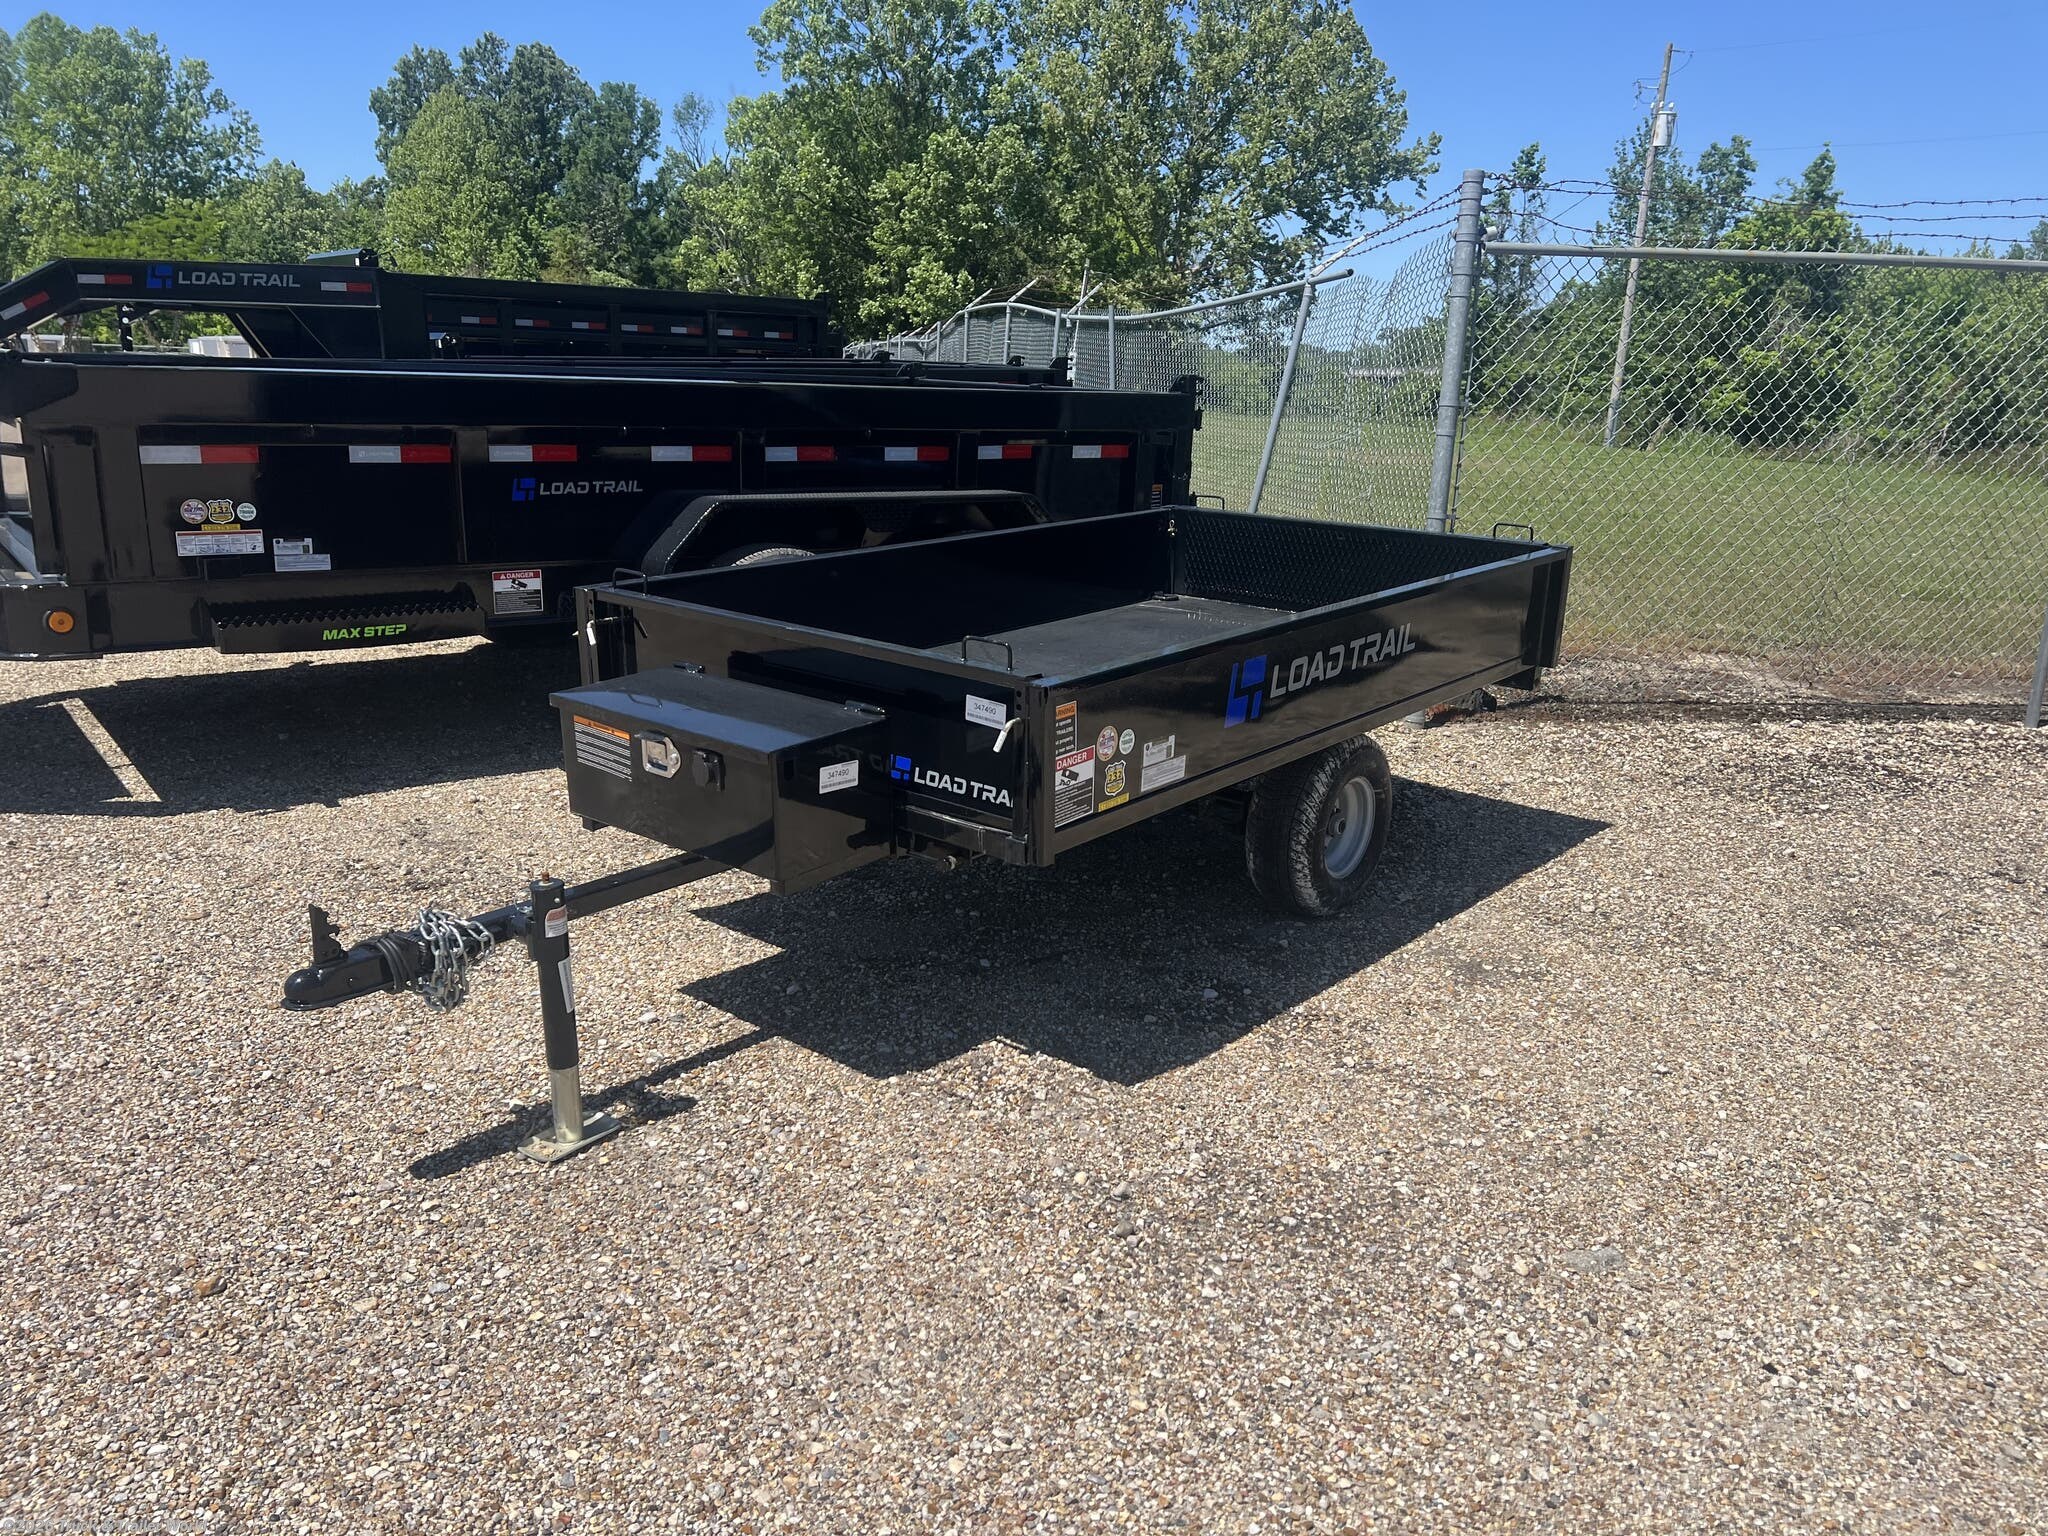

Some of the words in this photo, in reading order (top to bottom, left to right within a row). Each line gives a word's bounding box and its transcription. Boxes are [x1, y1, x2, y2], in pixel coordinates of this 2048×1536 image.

[178, 271, 236, 286] LOAD
[241, 272, 301, 288] TRAIL
[540, 482, 589, 495] LOAD
[592, 480, 643, 494] TRAIL
[322, 628, 361, 640] MAX
[364, 624, 407, 637] STEP
[1270, 644, 1345, 699] LOAD
[1350, 623, 1416, 671] TRAIL
[973, 702, 997, 716] 347490
[1056, 751, 1087, 770] DANGER
[827, 768, 850, 780] 347490
[1108, 770, 1122, 782] 232
[914, 767, 967, 795] LOAD
[970, 781, 1014, 808] TRA
